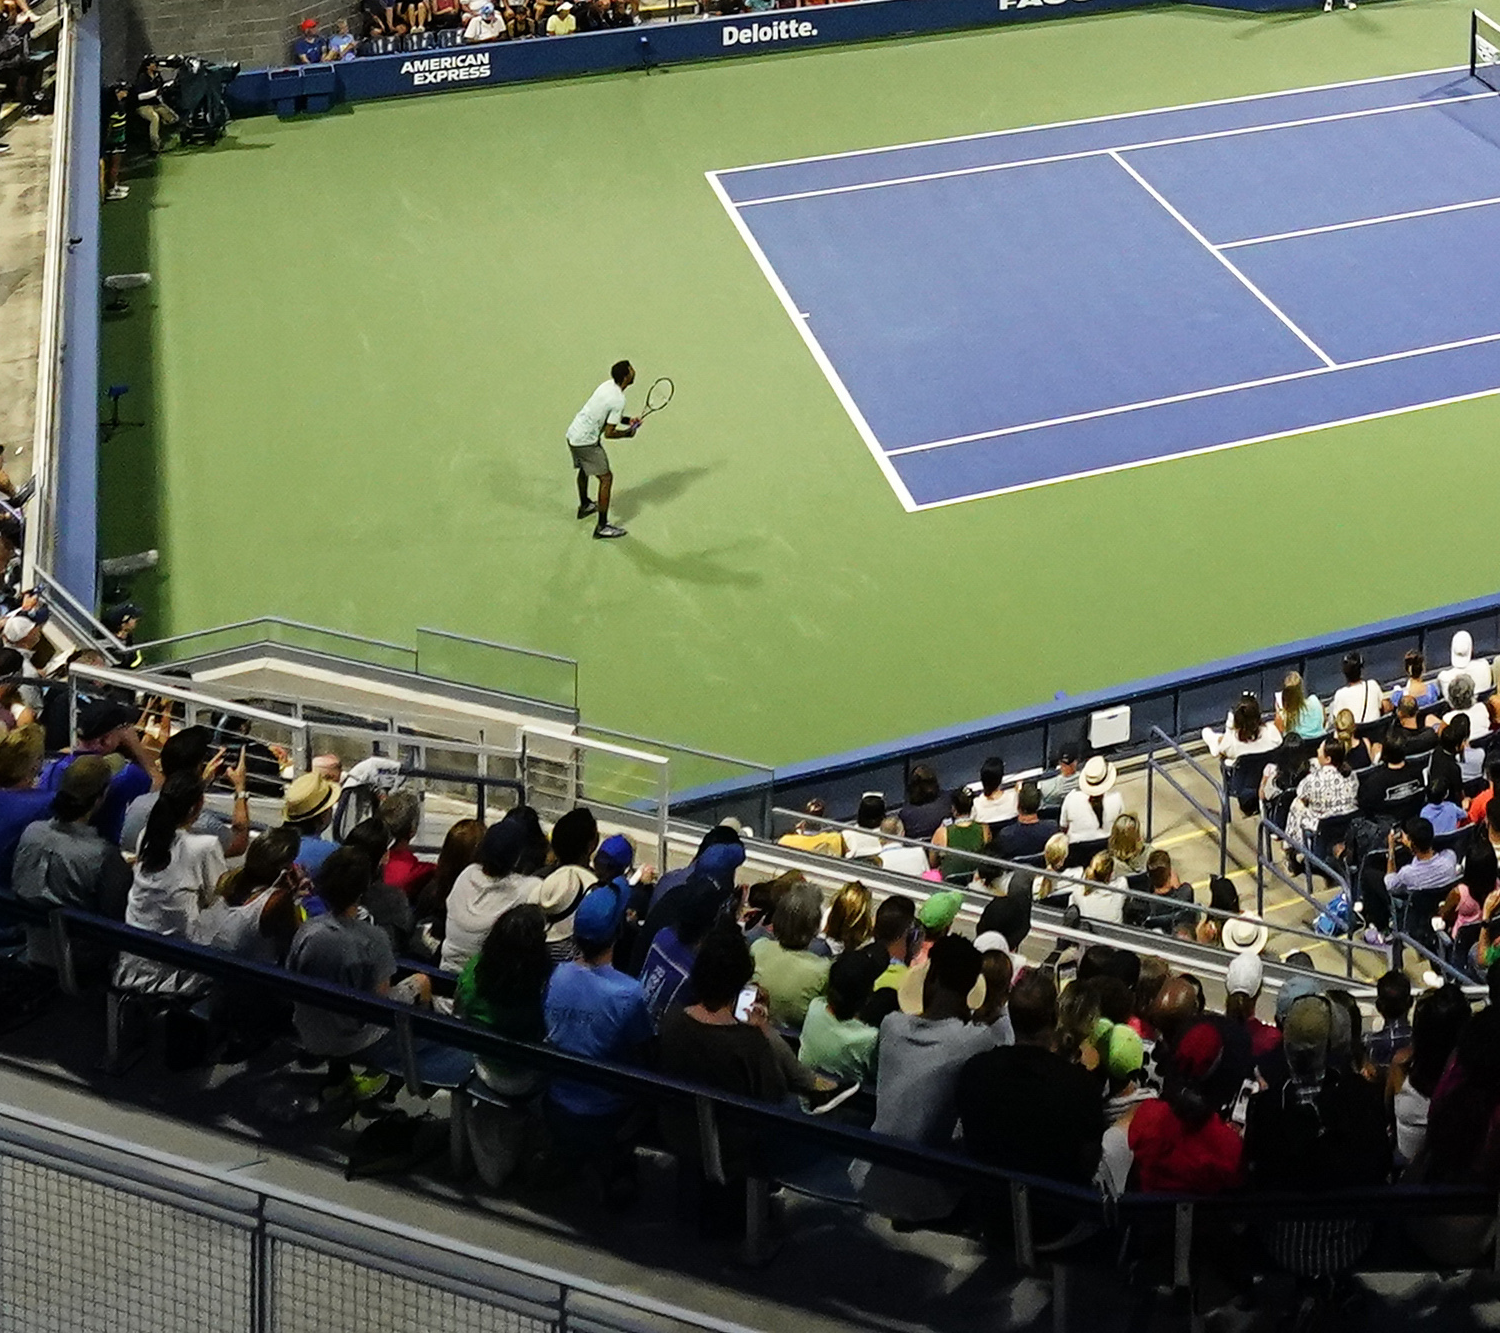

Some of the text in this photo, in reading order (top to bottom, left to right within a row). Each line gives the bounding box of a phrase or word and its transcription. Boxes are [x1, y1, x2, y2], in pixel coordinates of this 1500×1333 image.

[722, 19, 818, 46] Deloitte.
[401, 52, 490, 75] AMERICAN
[413, 64, 491, 86] EXPRESS
